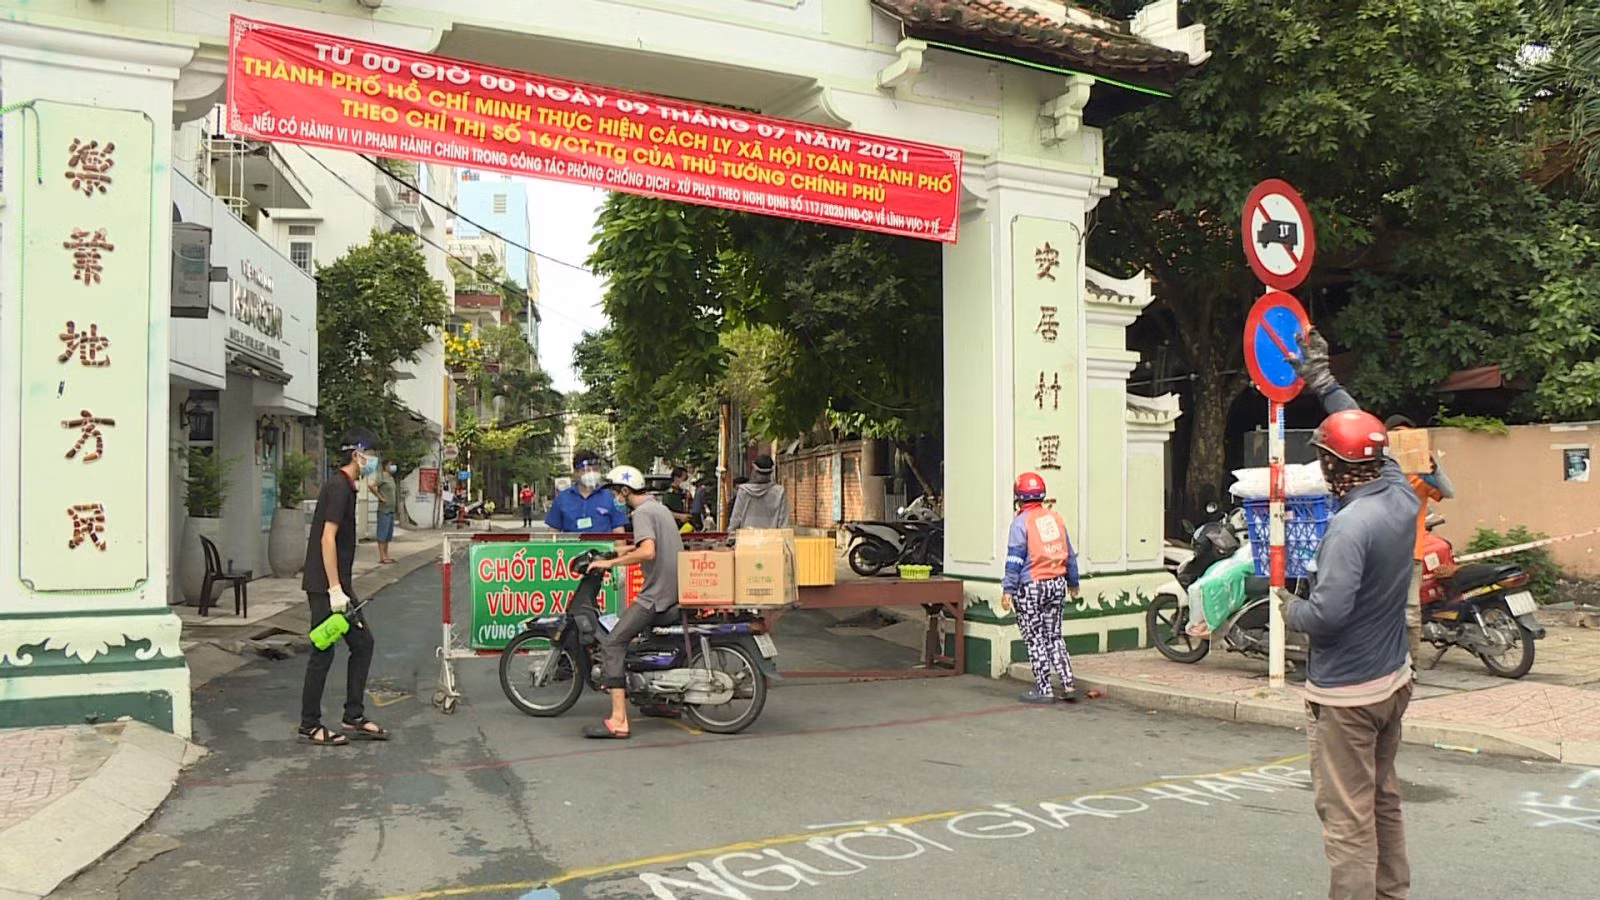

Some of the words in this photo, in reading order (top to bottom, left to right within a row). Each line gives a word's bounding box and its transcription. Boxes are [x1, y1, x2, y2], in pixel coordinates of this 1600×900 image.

[243, 56, 324, 87] THÀNH
[331, 71, 382, 96] PHỐ
[387, 79, 423, 103] HỒ
[428, 90, 470, 112] CHÍ
[475, 97, 531, 121] MINH
[537, 106, 593, 134] THỰC
[598, 117, 644, 143] HIỆN
[649, 126, 709, 151] CÁCH
[713, 136, 733, 154] LY
[737, 141, 764, 161] XÃ
[768, 145, 802, 170] HỘI
[806, 153, 854, 176] TOÀN
[858, 161, 913, 186] THÀNH
[918, 173, 953, 194] PHỐ
[314, 43, 354, 66] TỪ
[362, 52, 400, 73] 00
[410, 61, 471, 84] GIỜ
[480, 74, 516, 93] 00
[525, 81, 607, 108] NGÀY
[616, 98, 649, 115] 09
[656, 105, 750, 132] THÁNG
[756, 124, 786, 140] 07
[794, 129, 851, 153] NĂM
[858, 141, 910, 164] 2021
[252, 110, 275, 132] NẾU
[278, 115, 298, 135] CÓ
[300, 118, 333, 140] HÀNH
[337, 127, 348, 143] VI
[351, 129, 362, 144] VI
[365, 131, 398, 152] PHẠM
[400, 134, 432, 155] HÀNH
[434, 141, 469, 161] CHÍNH
[472, 147, 507, 166] TRONG
[510, 151, 542, 170] CÔNG
[545, 156, 565, 174] TÁC
[567, 161, 603, 181] PHÒNG
[606, 166, 643, 186] CHỐNG
[645, 174, 670, 192] DỊCH
[692, 181, 716, 201] PHẠT
[717, 186, 740, 202] THEO
[742, 190, 765, 210] NGHỊ
[790, 194, 804, 211] SỐ
[875, 207, 886, 225] VỀ
[924, 220, 930, 232] Y
[931, 218, 941, 234] TẾ
[341, 98, 399, 123] THEO
[405, 108, 447, 132] CHỈ
[453, 117, 486, 143] THỊ
[492, 121, 521, 143] SỐ
[528, 130, 627, 164] 16/CT-TTg
[632, 145, 676, 169] CỦA
[680, 154, 717, 175] THỦ
[721, 160, 786, 186] TƯỚNG
[790, 173, 847, 197] CHÍNH
[852, 182, 886, 203] PHỦ
[479, 548, 537, 582] CHỐT
[691, 559, 716, 572] Tipo
[487, 586, 545, 616] VÙNG
[478, 620, 516, 643] (VÙNG
[947, 793, 1150, 840] GIAO
